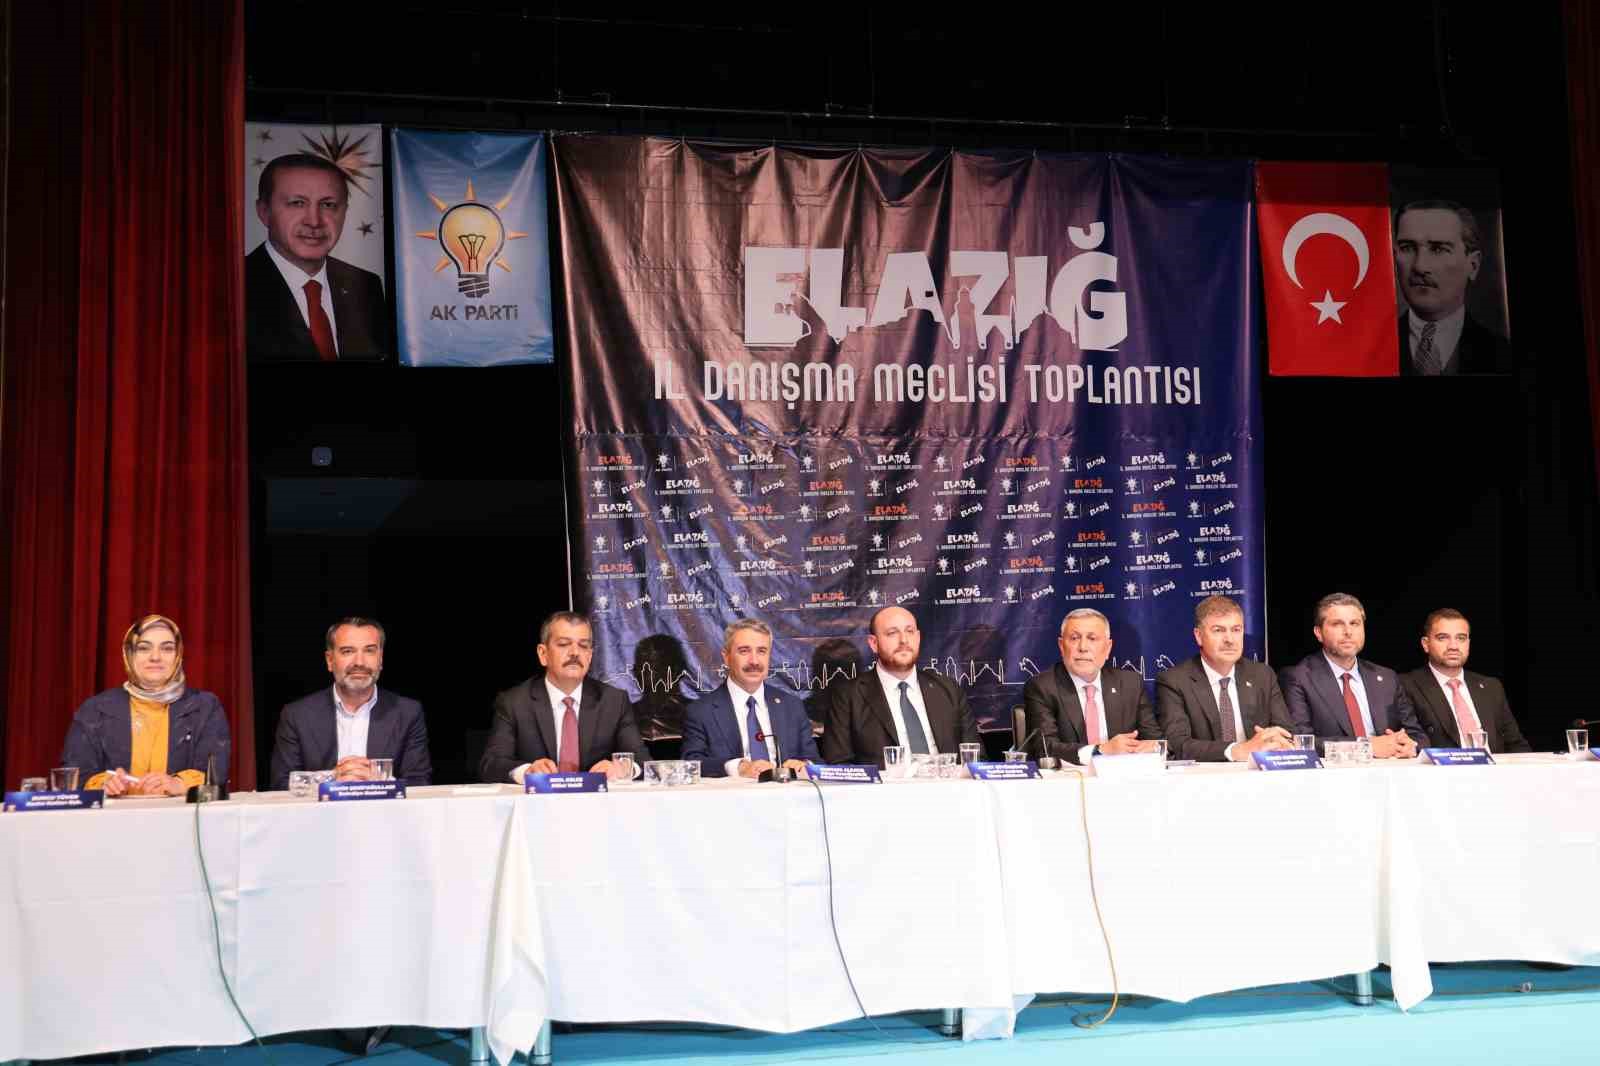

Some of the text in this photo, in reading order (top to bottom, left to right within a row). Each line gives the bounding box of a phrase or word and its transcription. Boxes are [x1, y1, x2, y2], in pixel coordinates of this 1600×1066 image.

[430, 304, 519, 321] AK PARTİ
[744, 222, 1128, 351] ELAZIĞ
[704, 360, 855, 410] DANIŞMA
[874, 356, 1007, 403] MECLİSİ
[1024, 364, 1201, 405] TOPLANTISI
